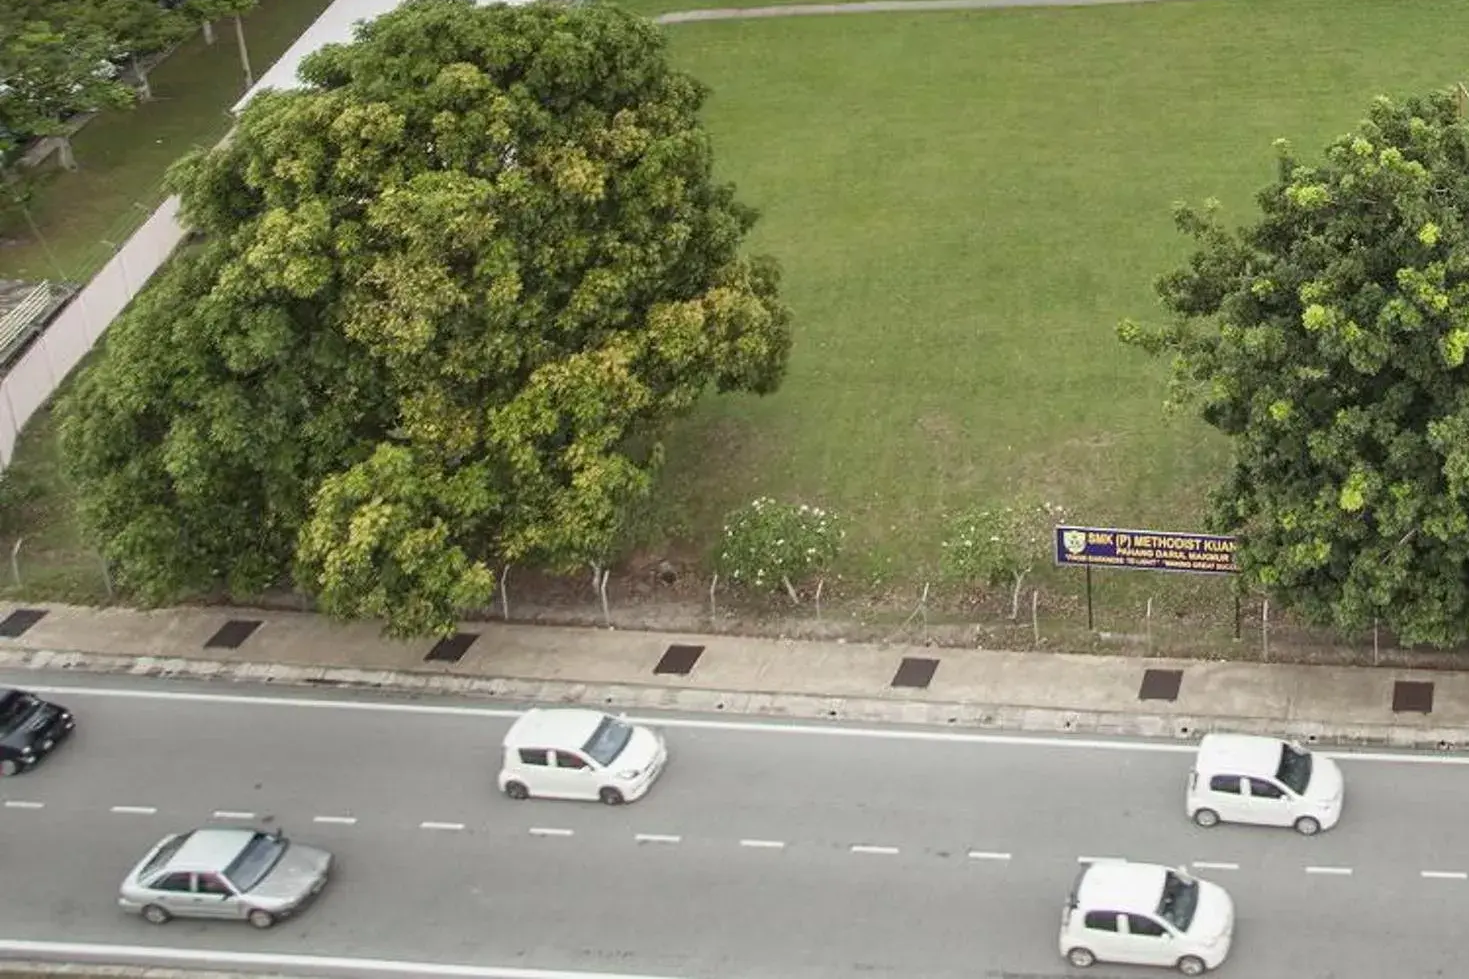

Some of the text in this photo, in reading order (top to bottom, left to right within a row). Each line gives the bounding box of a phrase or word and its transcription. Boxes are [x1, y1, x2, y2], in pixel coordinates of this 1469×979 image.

[1088, 532, 1113, 545] SMK
[1116, 533, 1131, 548] (P)
[1134, 535, 1202, 551] METHODIST
